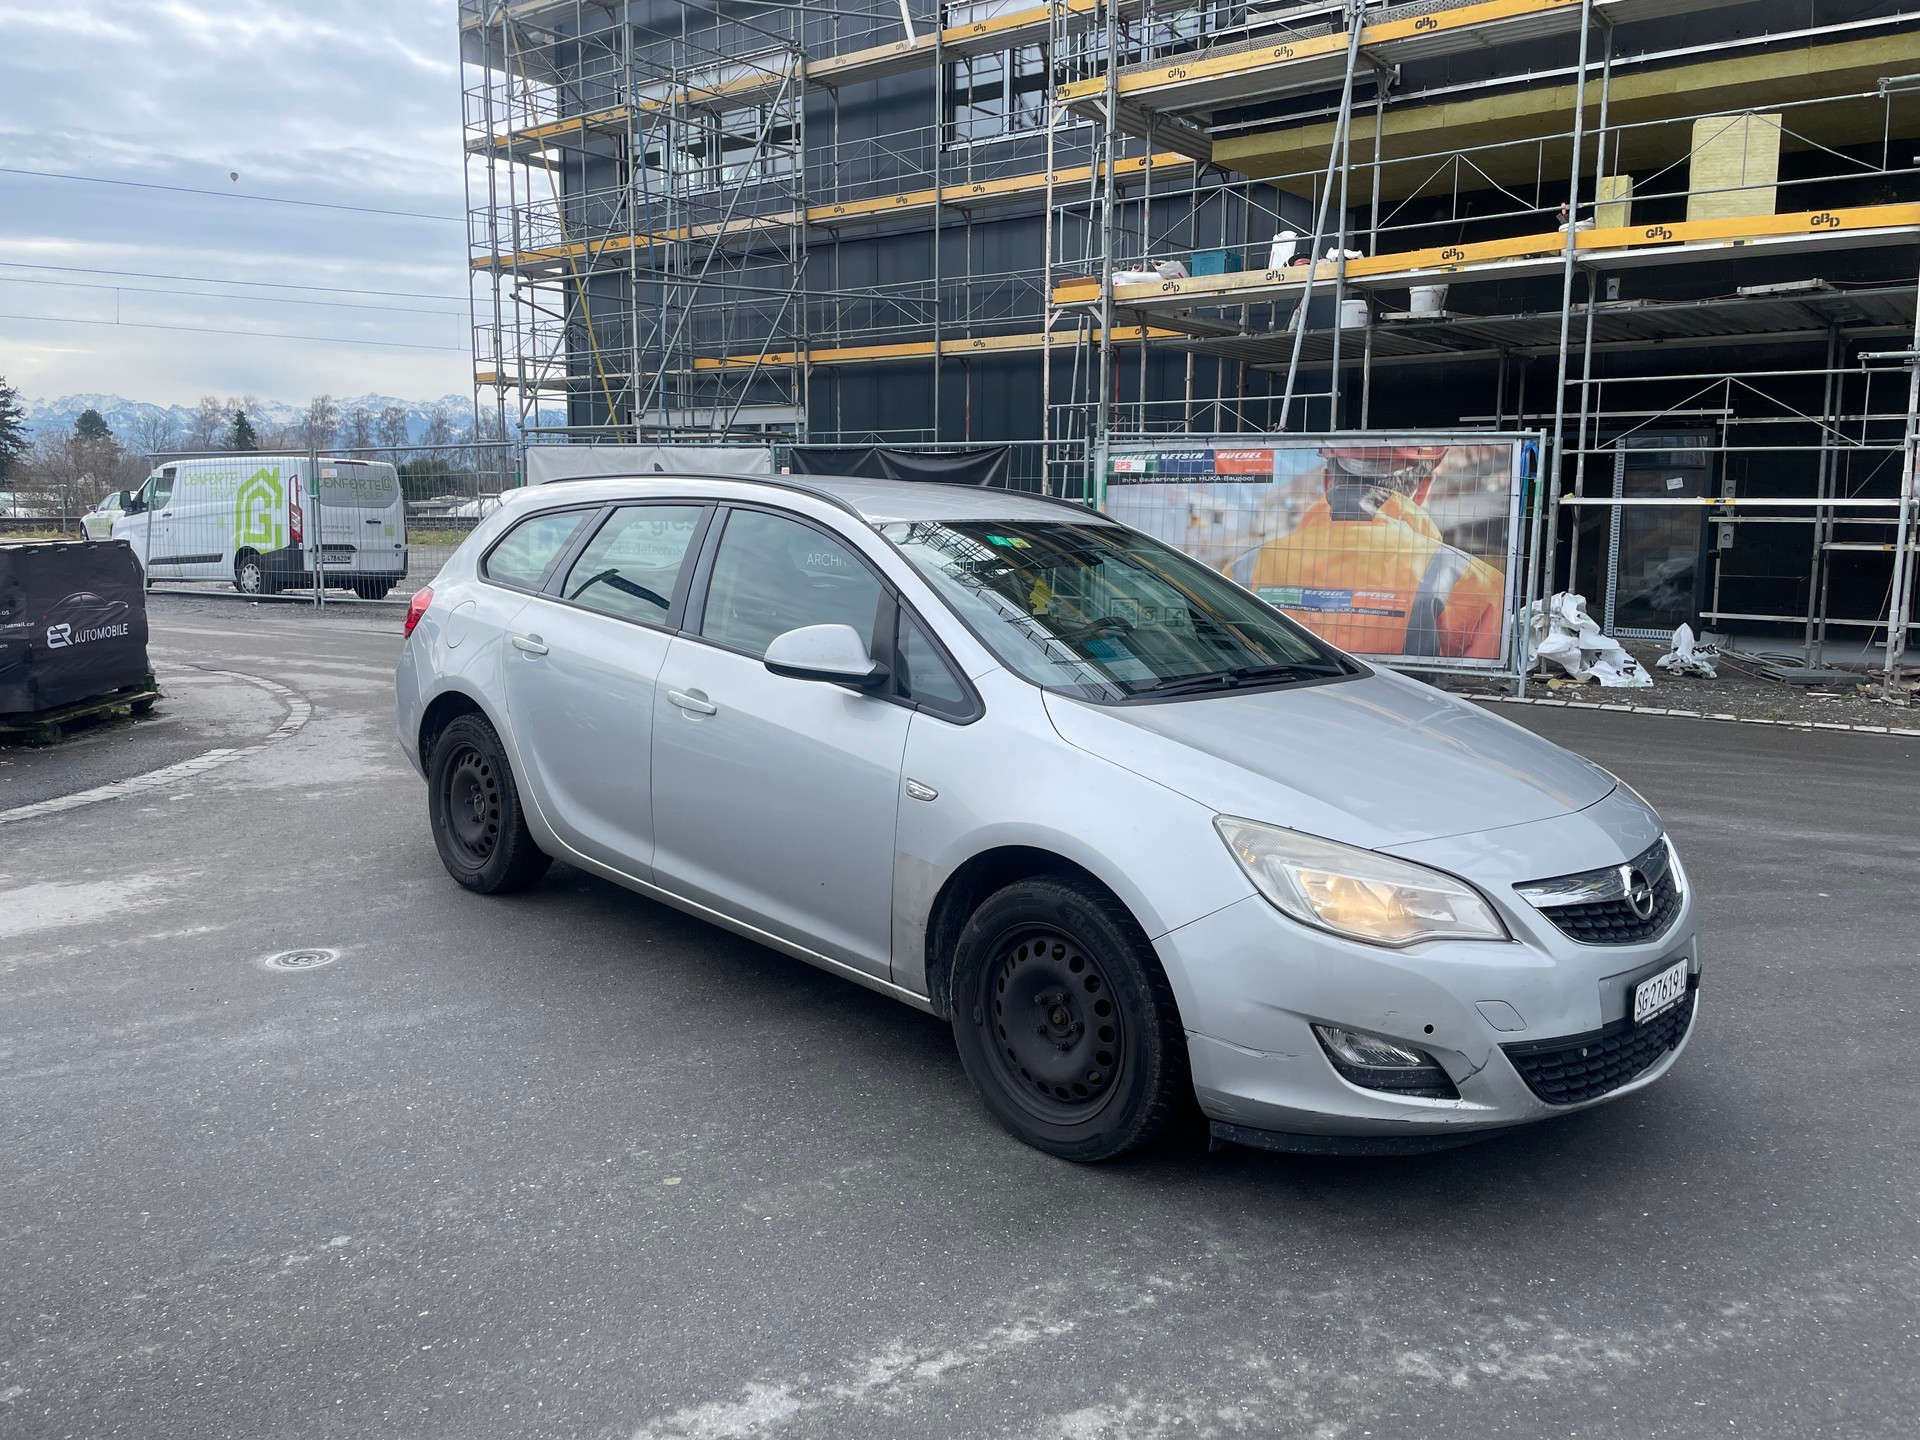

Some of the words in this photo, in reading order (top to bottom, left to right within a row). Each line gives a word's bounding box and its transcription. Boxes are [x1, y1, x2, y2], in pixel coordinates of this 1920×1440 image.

[1414, 17, 1437, 30] GBD
[1274, 46, 1293, 58] GBD
[1168, 68, 1186, 79] GBD
[1810, 212, 1840, 228] GBD
[1646, 226, 1672, 240] GBD
[1442, 248, 1464, 260] GBD
[1266, 270, 1284, 282] GBD
[1162, 282, 1180, 292] GBD
[1160, 452, 1205, 460] VETSCH
[1114, 461, 1132, 469] SFS
[184, 472, 237, 486] CONFORTE
[1139, 476, 1180, 484] Baupartner
[75, 623, 129, 644] AUTOMOBILE
